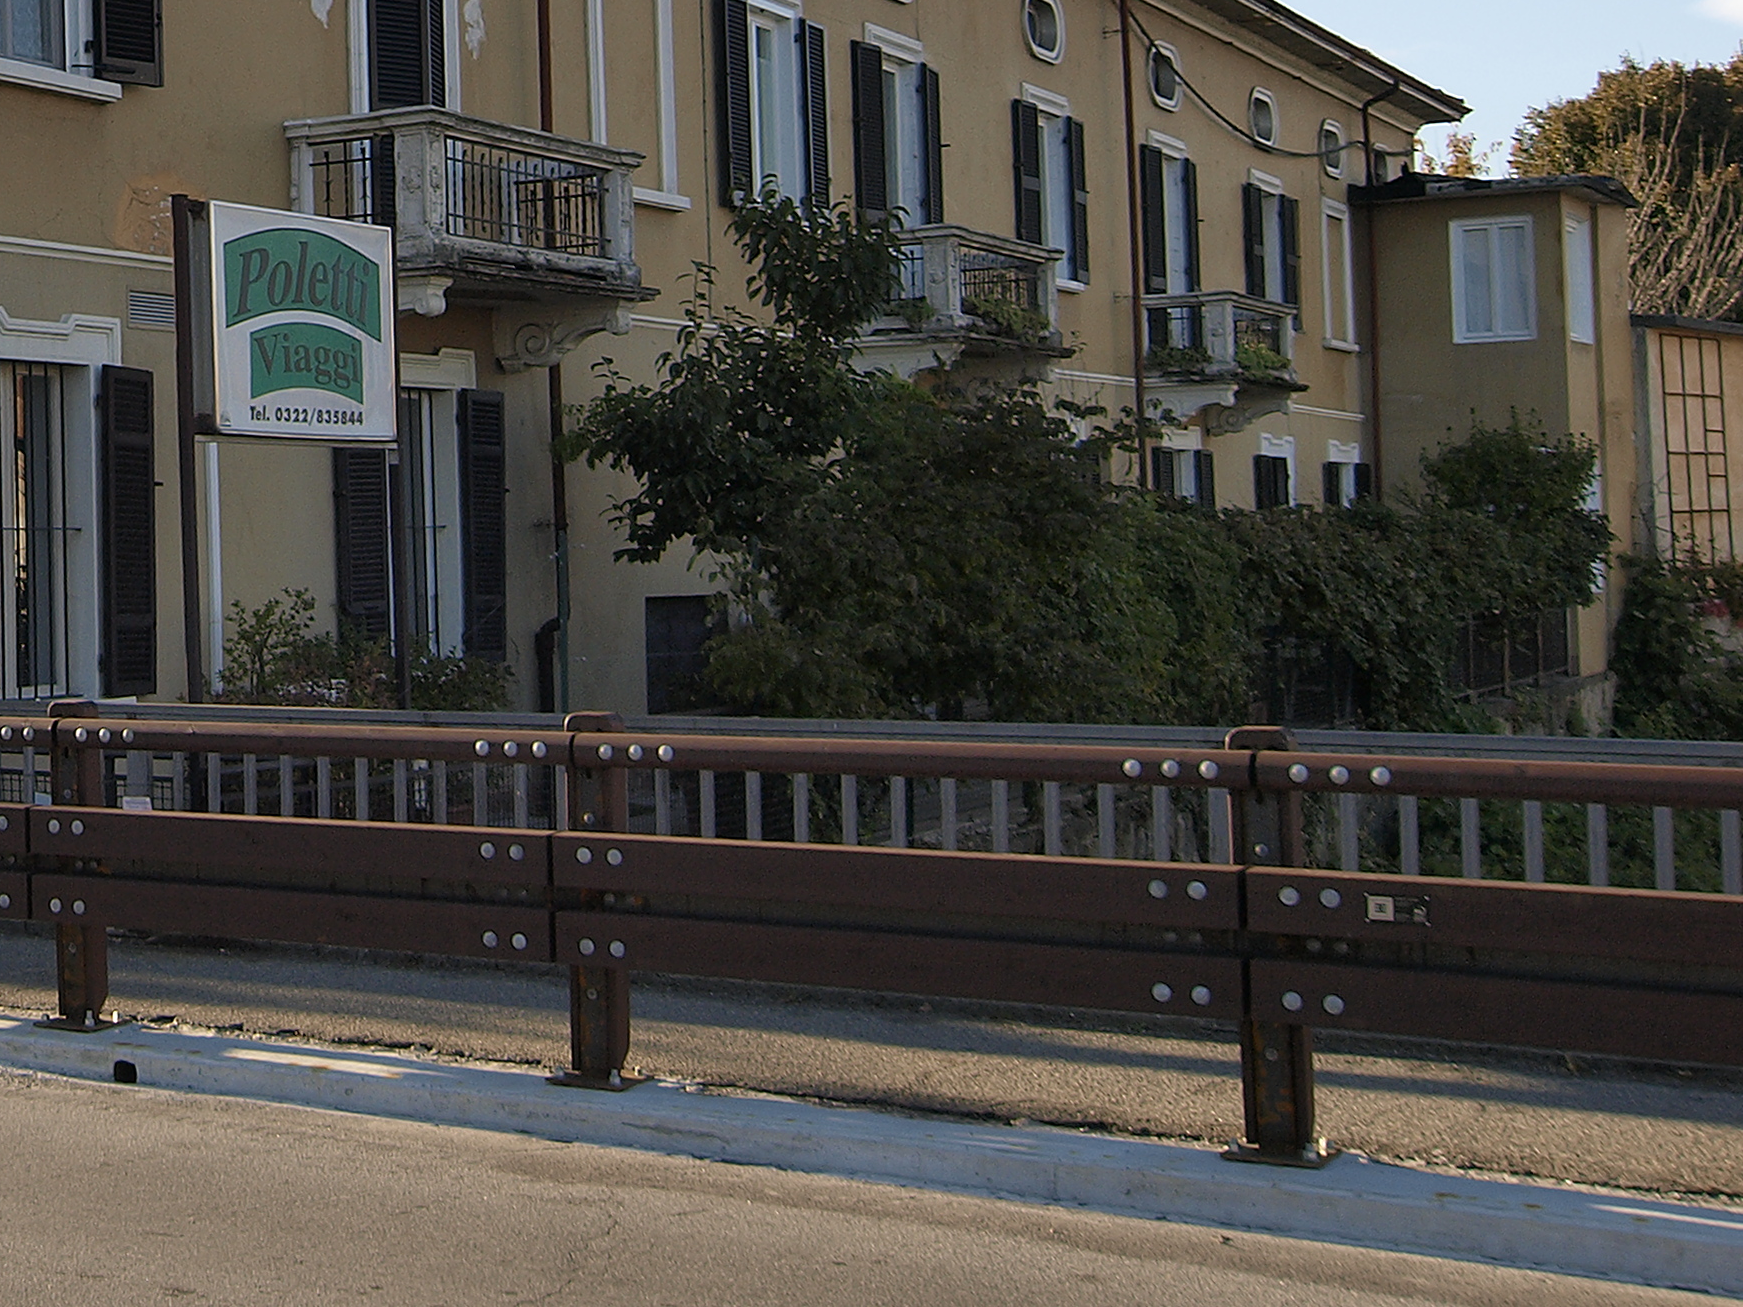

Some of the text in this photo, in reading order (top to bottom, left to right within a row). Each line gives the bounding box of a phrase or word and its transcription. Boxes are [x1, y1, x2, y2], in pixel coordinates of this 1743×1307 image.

[233, 241, 371, 327] Poletti
[254, 333, 362, 389] Viaggi
[250, 404, 364, 426] Tel. 0322/835844
